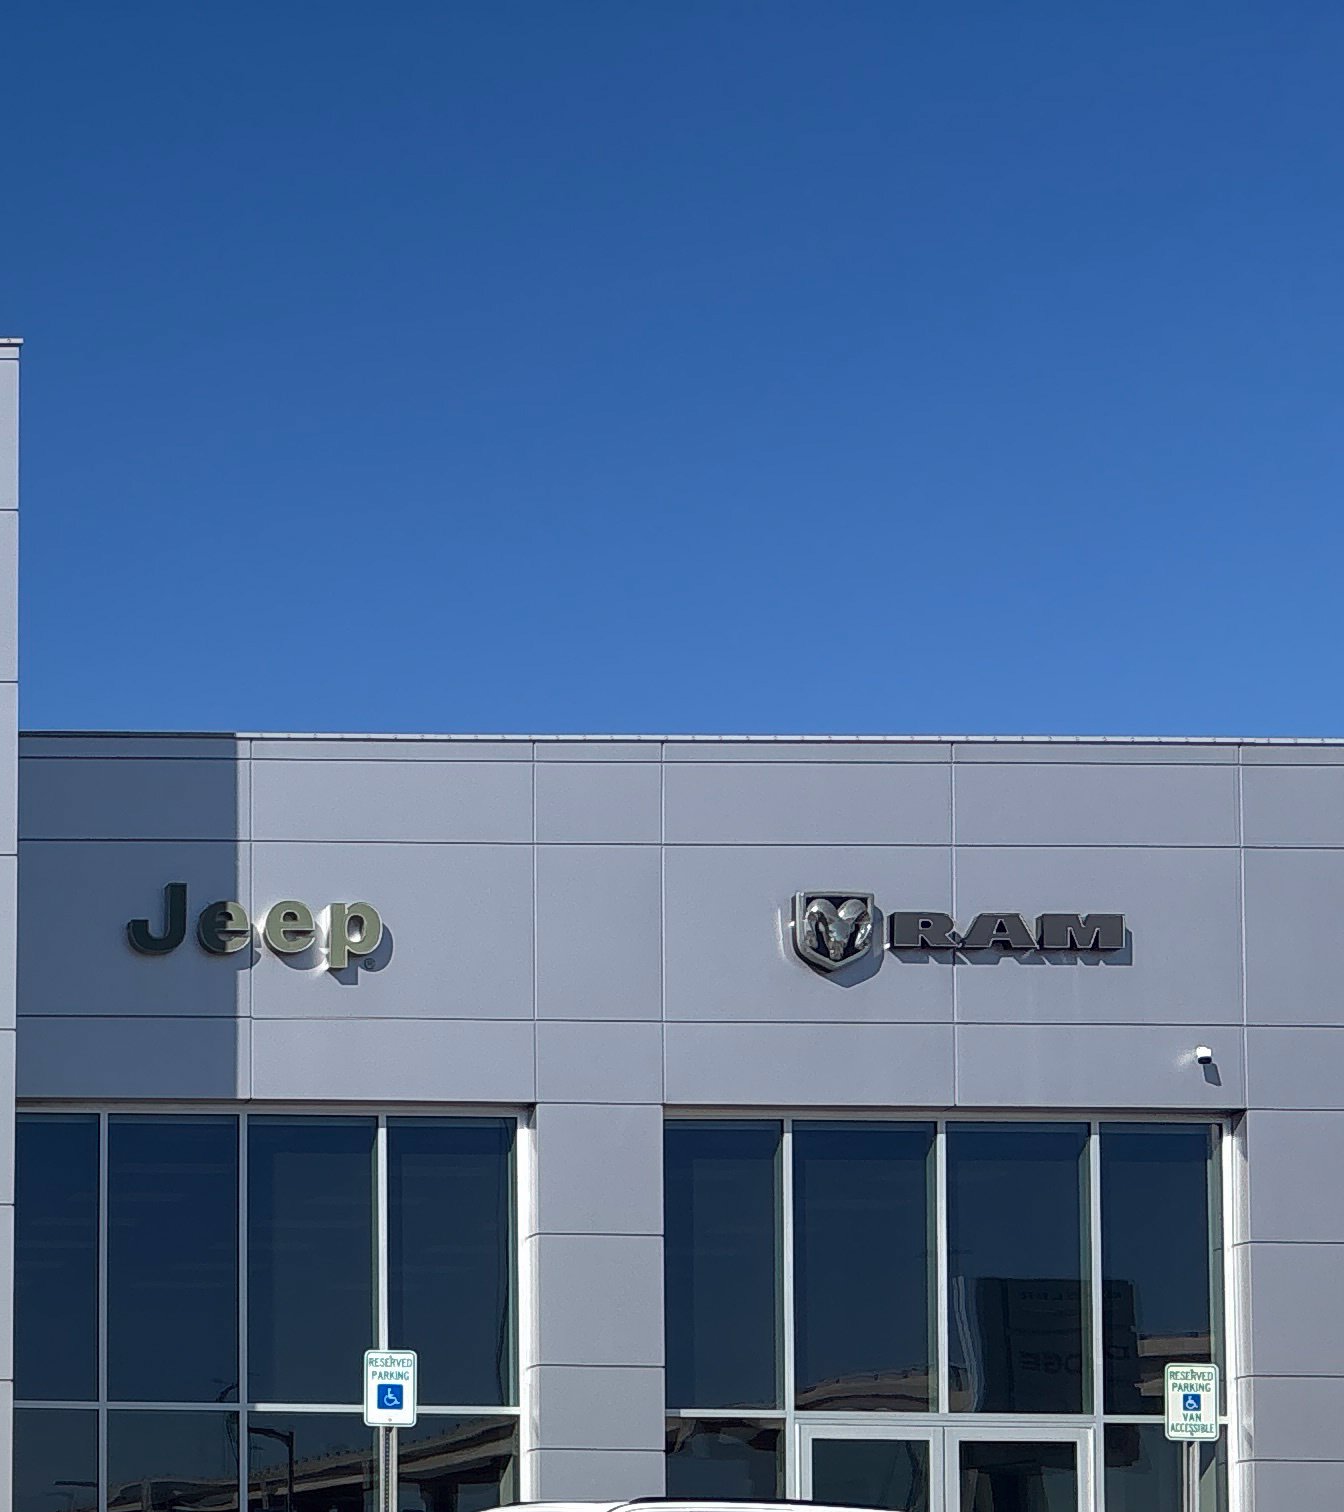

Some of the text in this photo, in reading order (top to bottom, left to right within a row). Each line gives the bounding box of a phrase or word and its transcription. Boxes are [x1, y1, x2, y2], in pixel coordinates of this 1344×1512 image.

[127, 882, 382, 968] Jeep
[890, 911, 1126, 950] RAM
[369, 1357, 412, 1368] RESERVED
[371, 1370, 410, 1381] PARKING
[1169, 1370, 1214, 1381] RESERVED
[1171, 1382, 1211, 1392] PARKING
[1182, 1412, 1202, 1422] VAN
[1170, 1423, 1214, 1434] ACCESSIBLE
